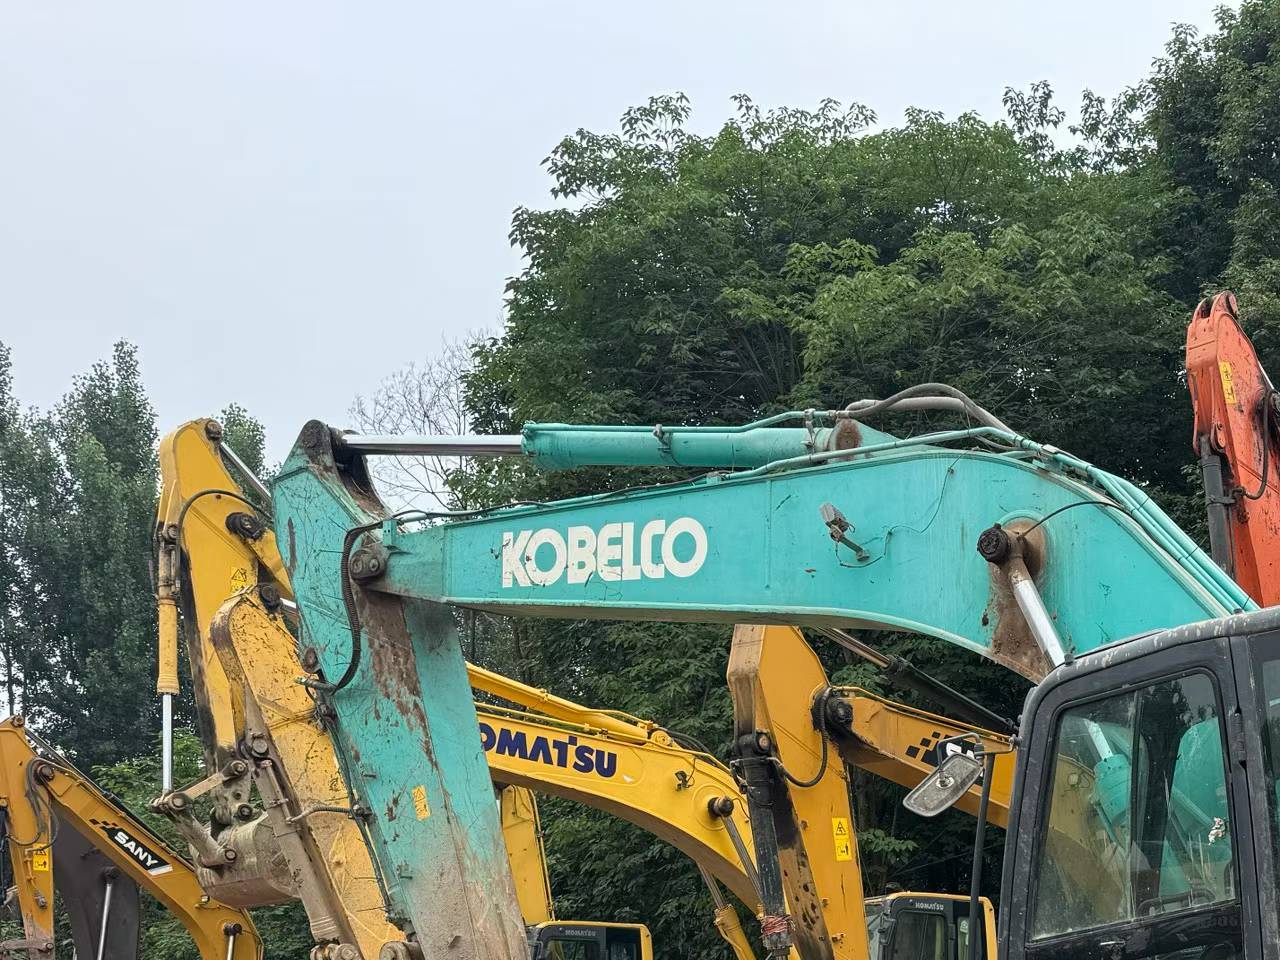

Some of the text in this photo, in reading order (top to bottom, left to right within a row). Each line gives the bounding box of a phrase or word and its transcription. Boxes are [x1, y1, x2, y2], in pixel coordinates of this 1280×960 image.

[502, 516, 708, 589] KOBELCO
[478, 722, 617, 778] OMATSU
[114, 831, 158, 867] SANY
